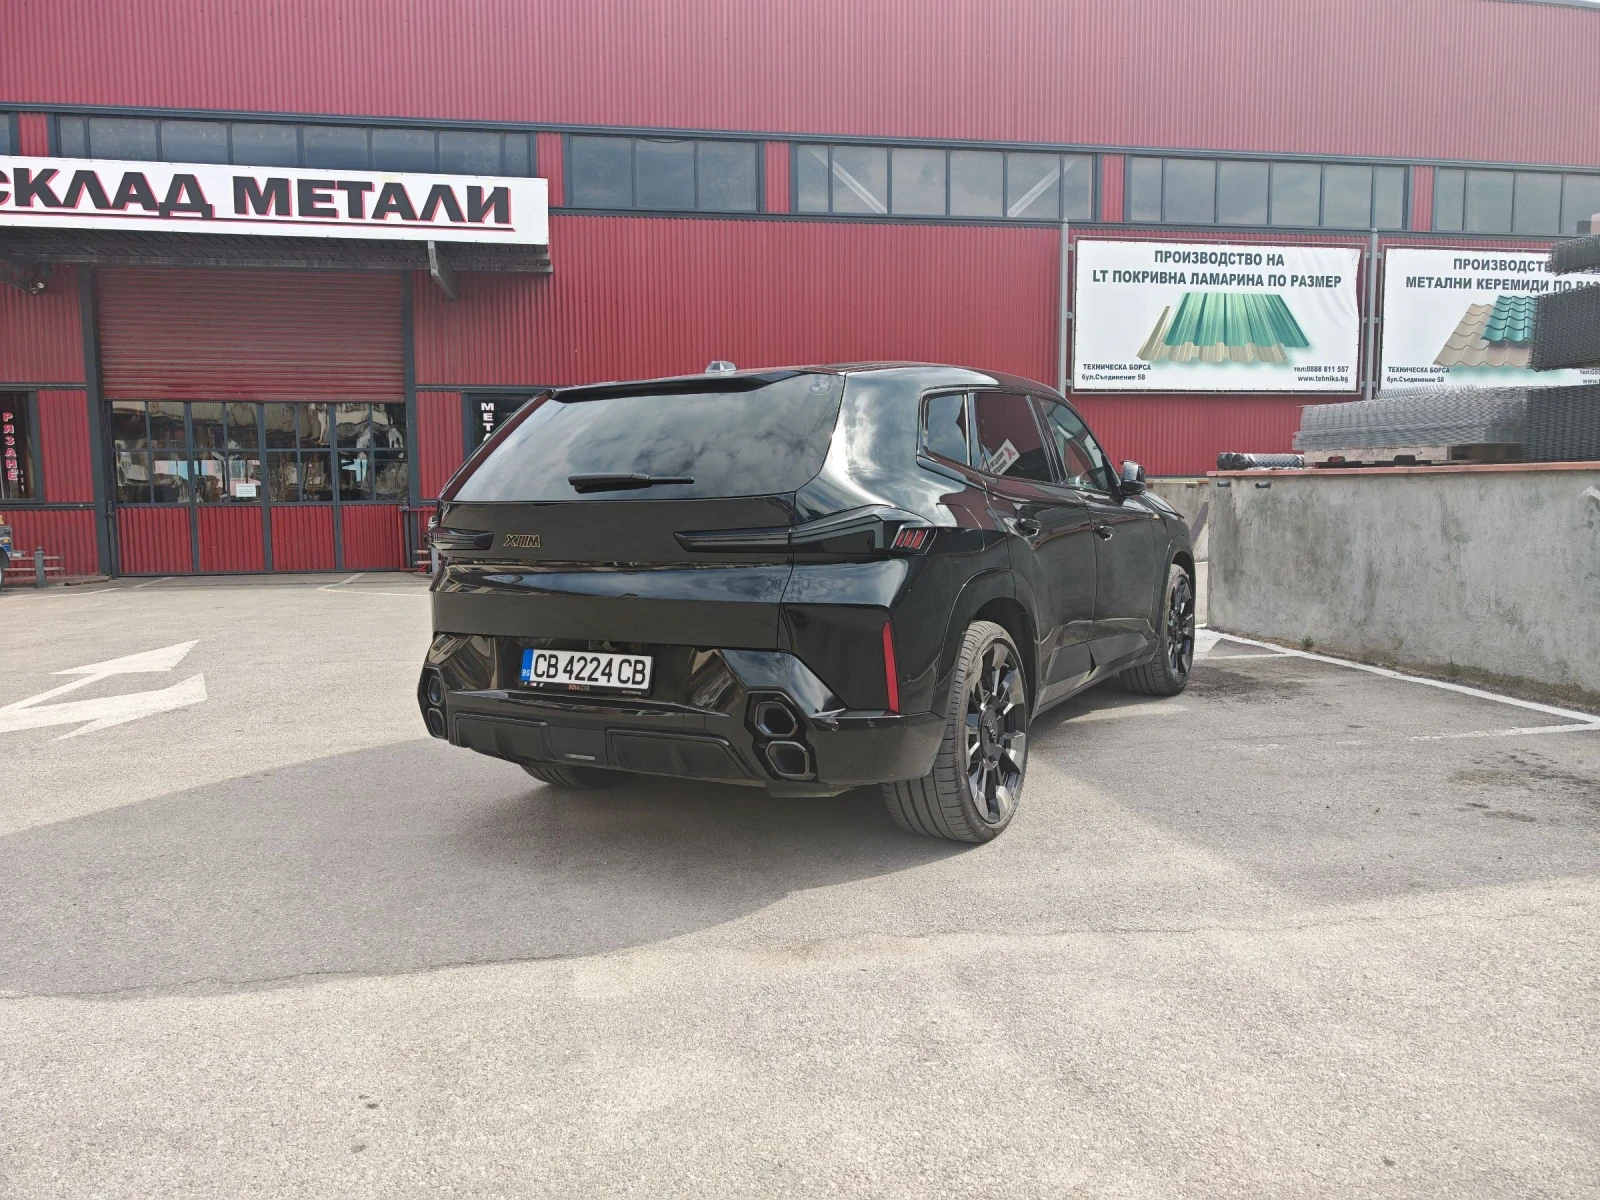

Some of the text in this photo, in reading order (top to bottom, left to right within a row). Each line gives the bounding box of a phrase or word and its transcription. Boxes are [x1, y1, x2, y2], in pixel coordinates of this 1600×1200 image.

[0, 167, 512, 225] КЛАД МЕТАЛИ
[1154, 250, 1285, 267] ПРОИЗВОДСТВО НА
[1092, 269, 1342, 288] LT ПОКРИВНА ЛАМАРИНА ПО РАЗМЕР
[1405, 276, 1472, 290] МЕТАЛНИ
[1476, 278, 1549, 294] КЕРЕМИДИ
[1553, 280, 1572, 292] ПО
[1083, 363, 1152, 371] ТЕХНИЧЕСКА БОРСА
[1137, 373, 1146, 381] 58
[1297, 375, 1349, 384] www.tehniks.bg
[2, 412, 18, 481] РЯЗАНЕ
[533, 653, 646, 685] CB 4224 CB
